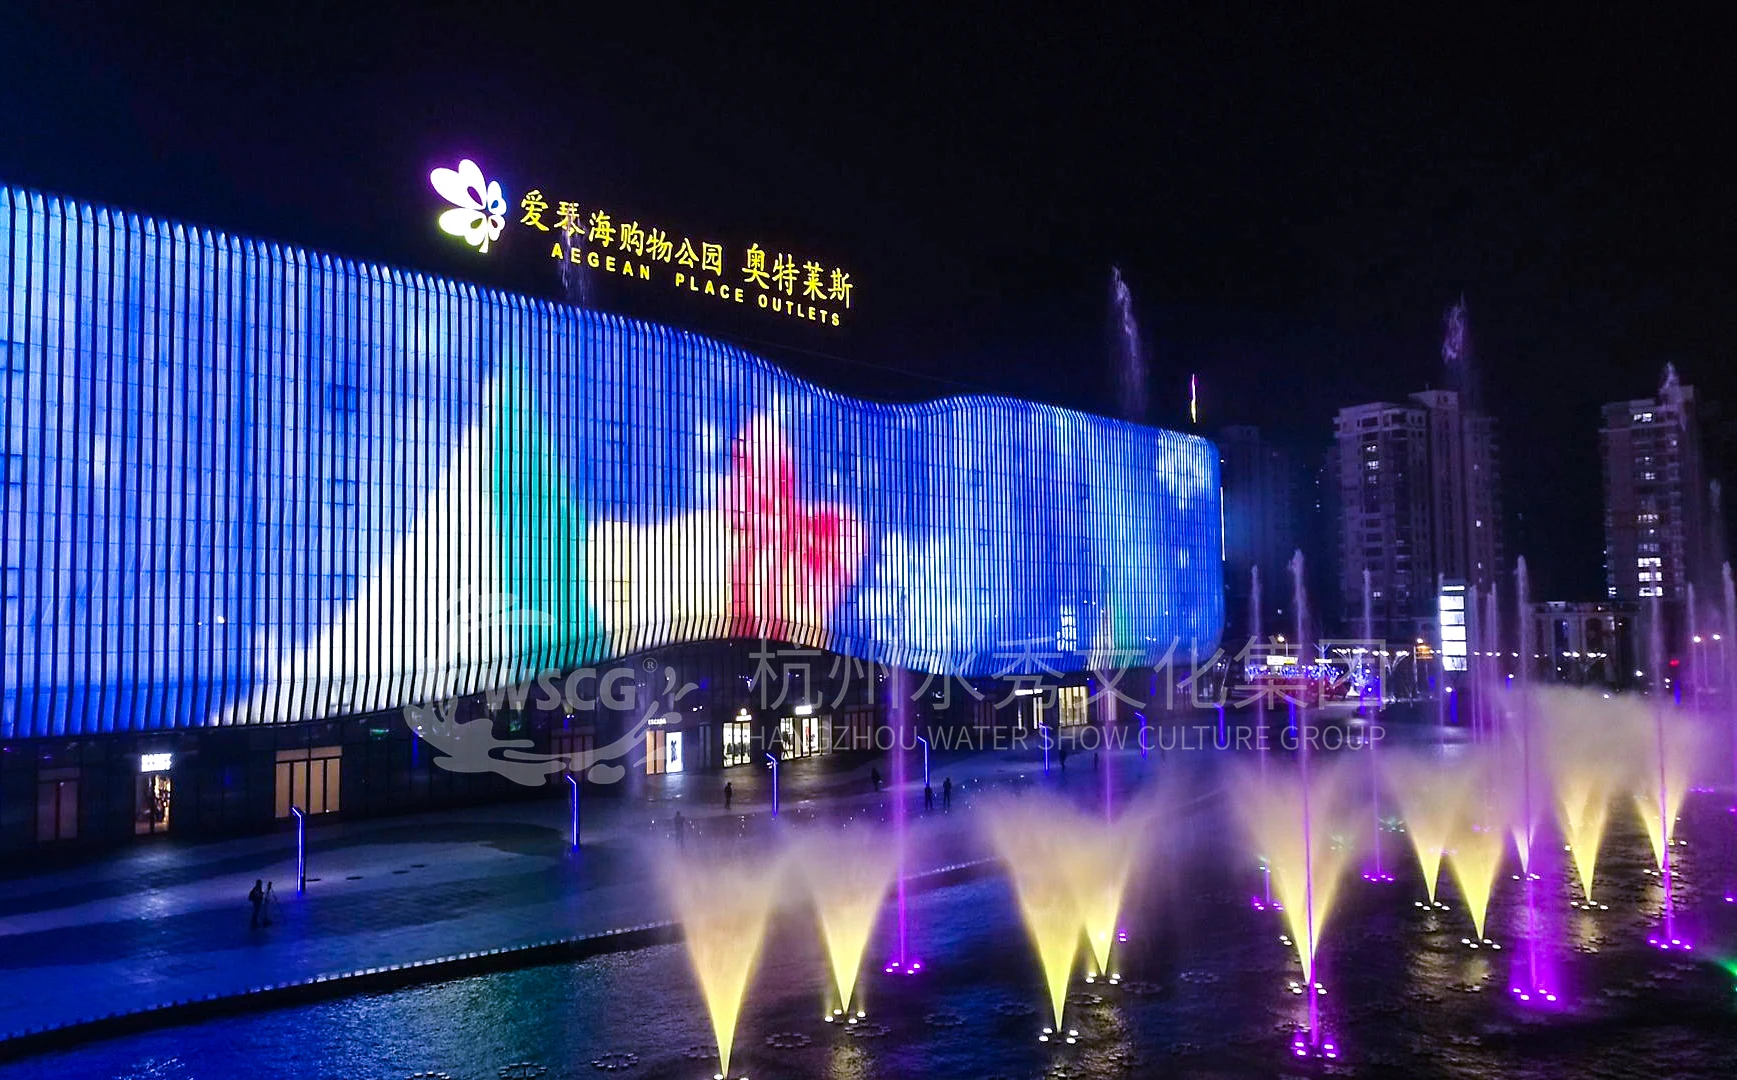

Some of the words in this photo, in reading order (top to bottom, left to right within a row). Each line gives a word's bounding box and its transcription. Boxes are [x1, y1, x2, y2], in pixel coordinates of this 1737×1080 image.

[520, 189, 721, 277] 爱琴海购物公园
[741, 242, 854, 309] 奥特莱斯
[551, 242, 650, 281] AEGEAN
[675, 272, 744, 303] PLACE
[757, 294, 841, 327] OUTLETS
